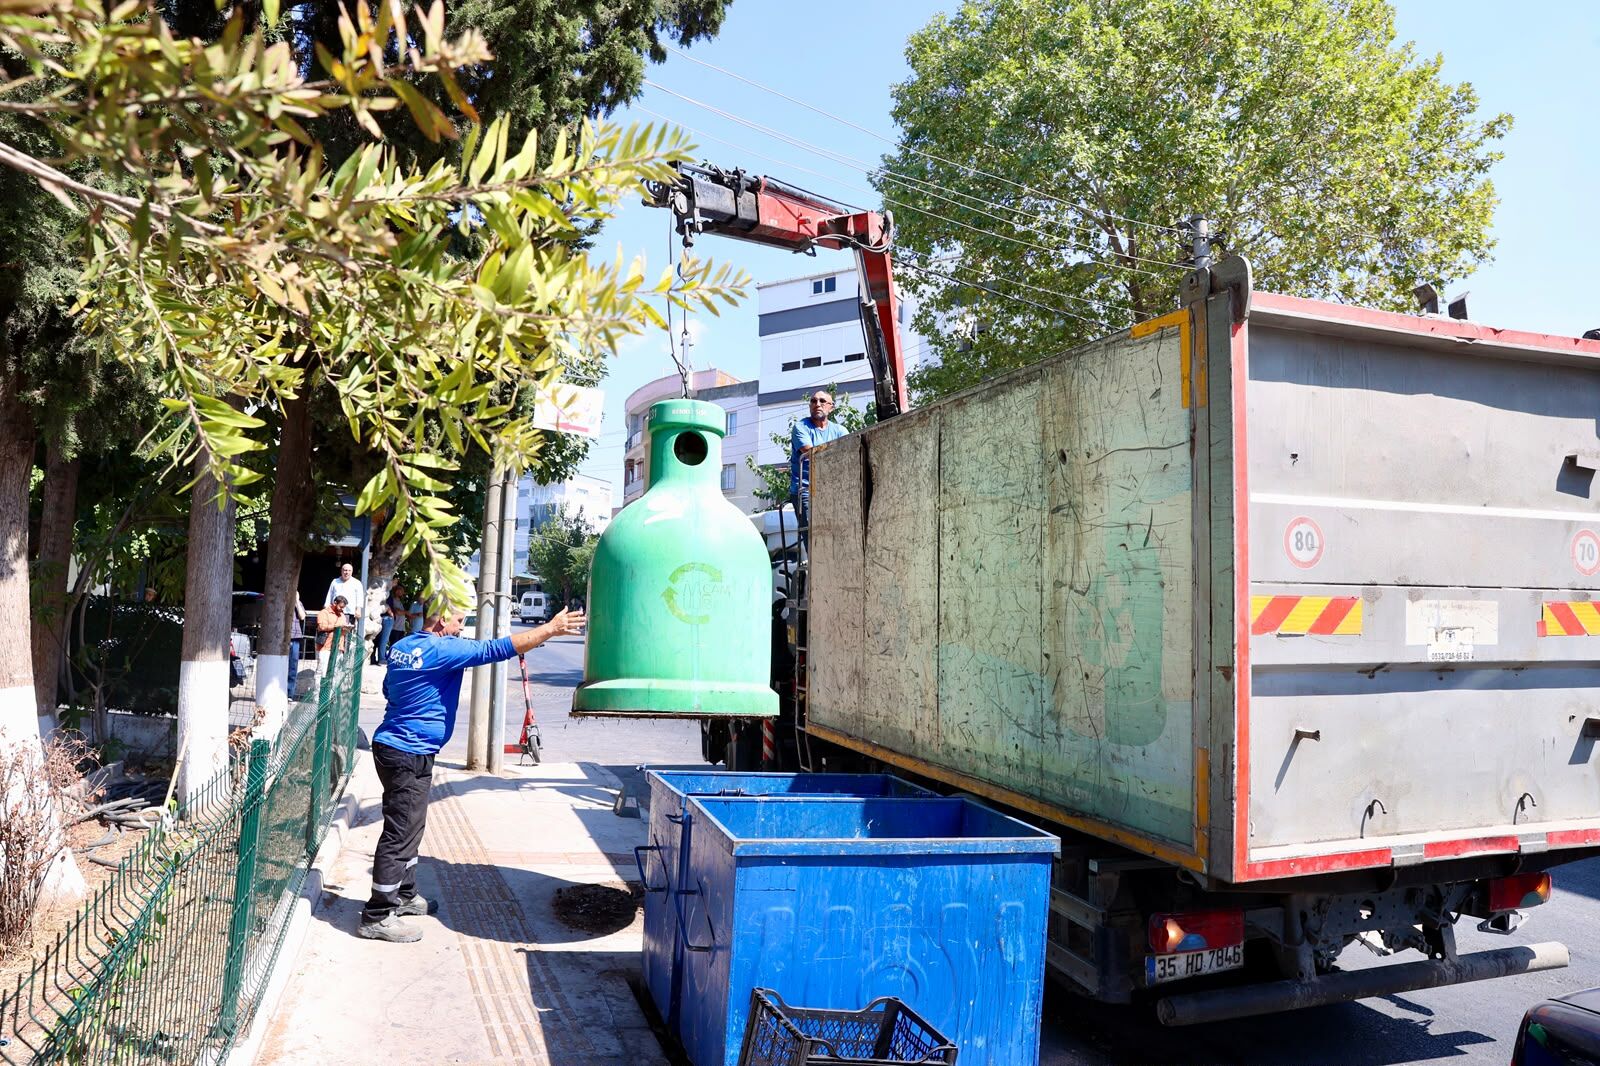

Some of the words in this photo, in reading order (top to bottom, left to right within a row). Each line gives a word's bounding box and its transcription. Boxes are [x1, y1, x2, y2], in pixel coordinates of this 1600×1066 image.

[1295, 531, 1315, 551] 80
[1579, 543, 1595, 561] 70
[1157, 956, 1177, 979] 35
[1208, 945, 1242, 970] 7846
